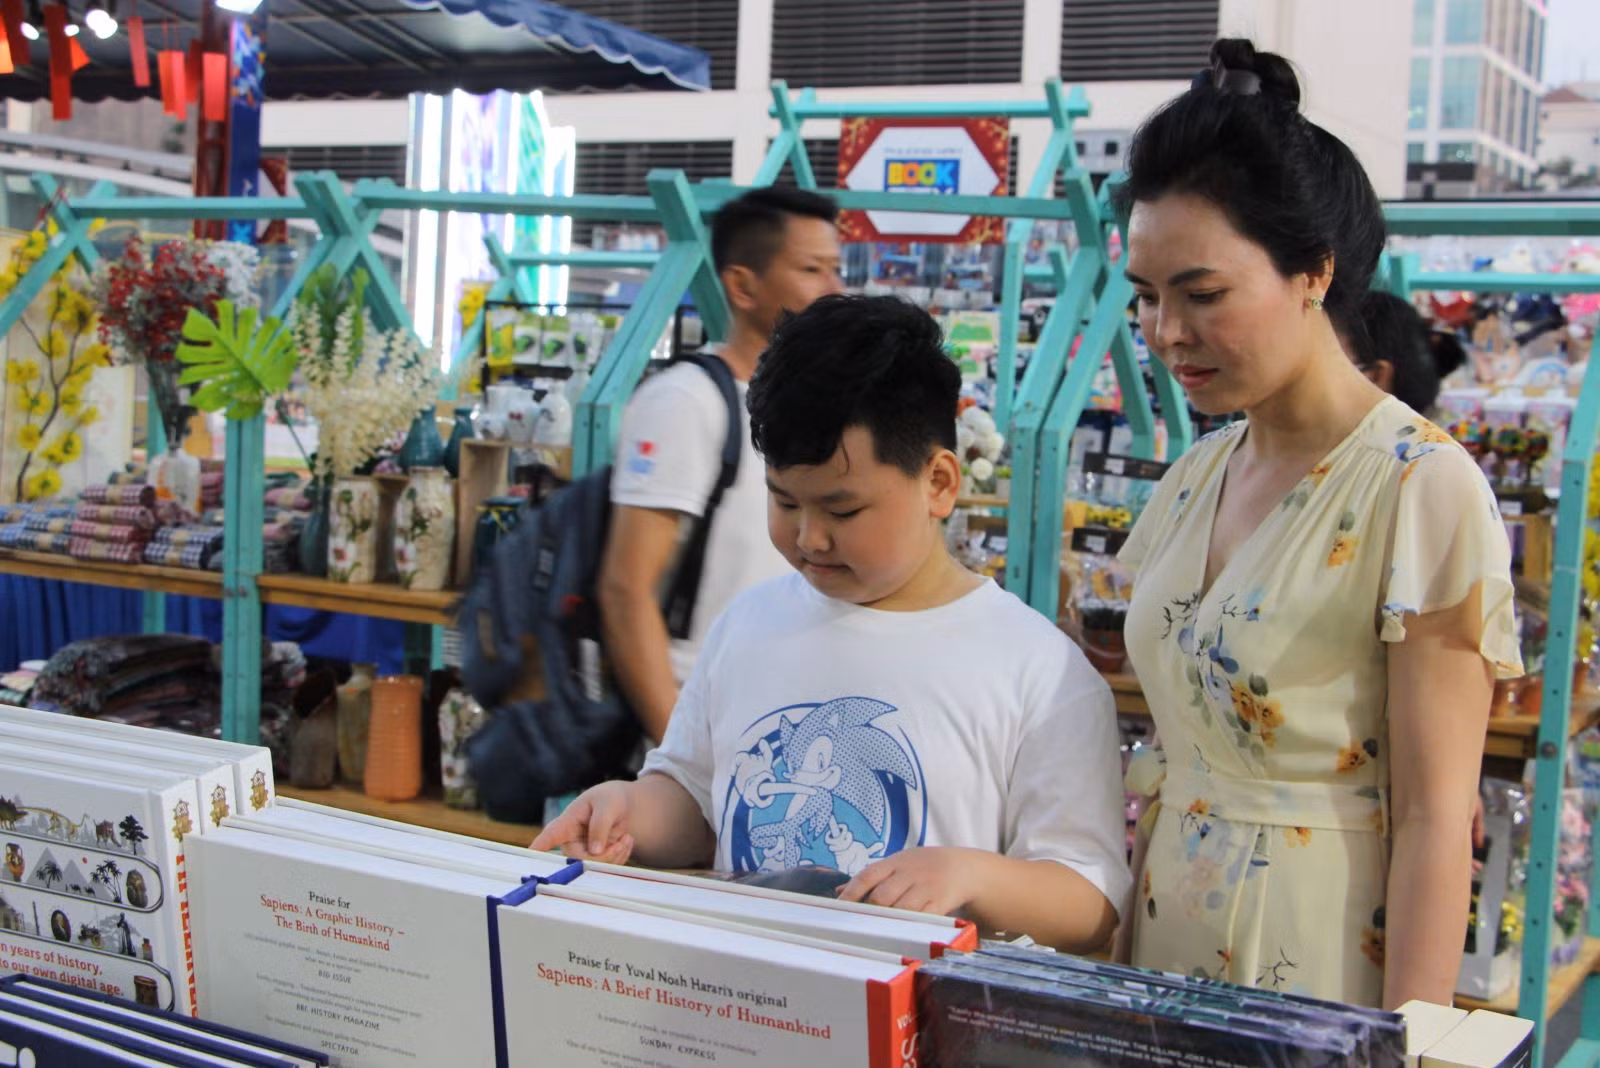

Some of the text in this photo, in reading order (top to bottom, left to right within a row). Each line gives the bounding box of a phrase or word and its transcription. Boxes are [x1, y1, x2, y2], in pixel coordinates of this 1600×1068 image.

[888, 161, 955, 187] BOOK
[260, 894, 303, 913] Sapiens:
[305, 906, 313, 917] A
[315, 909, 353, 925] Graphic
[355, 916, 394, 935] History
[308, 891, 351, 909] Praise for
[274, 915, 390, 951] The Birth of Humankind
[11, 944, 41, 960] years
[43, 951, 54, 962] of
[57, 953, 103, 976] history,
[11, 962, 30, 973] our
[32, 967, 58, 980] own
[60, 972, 97, 990] digital
[100, 984, 125, 997] age.
[568, 951, 787, 1008] Praise for Yuval Noah Harari's original
[537, 963, 598, 990] Sapiens:
[601, 978, 612, 993] A
[615, 980, 652, 1000] Brief
[656, 988, 712, 1017] History
[717, 1005, 732, 1018] of
[737, 1006, 831, 1040] Humankind
[311, 1007, 341, 1021] HISTORY
[343, 1015, 380, 1030] MAGAZINE
[320, 1040, 359, 1056] SPECTATOR
[640, 1036, 672, 1050] SUNDAY
